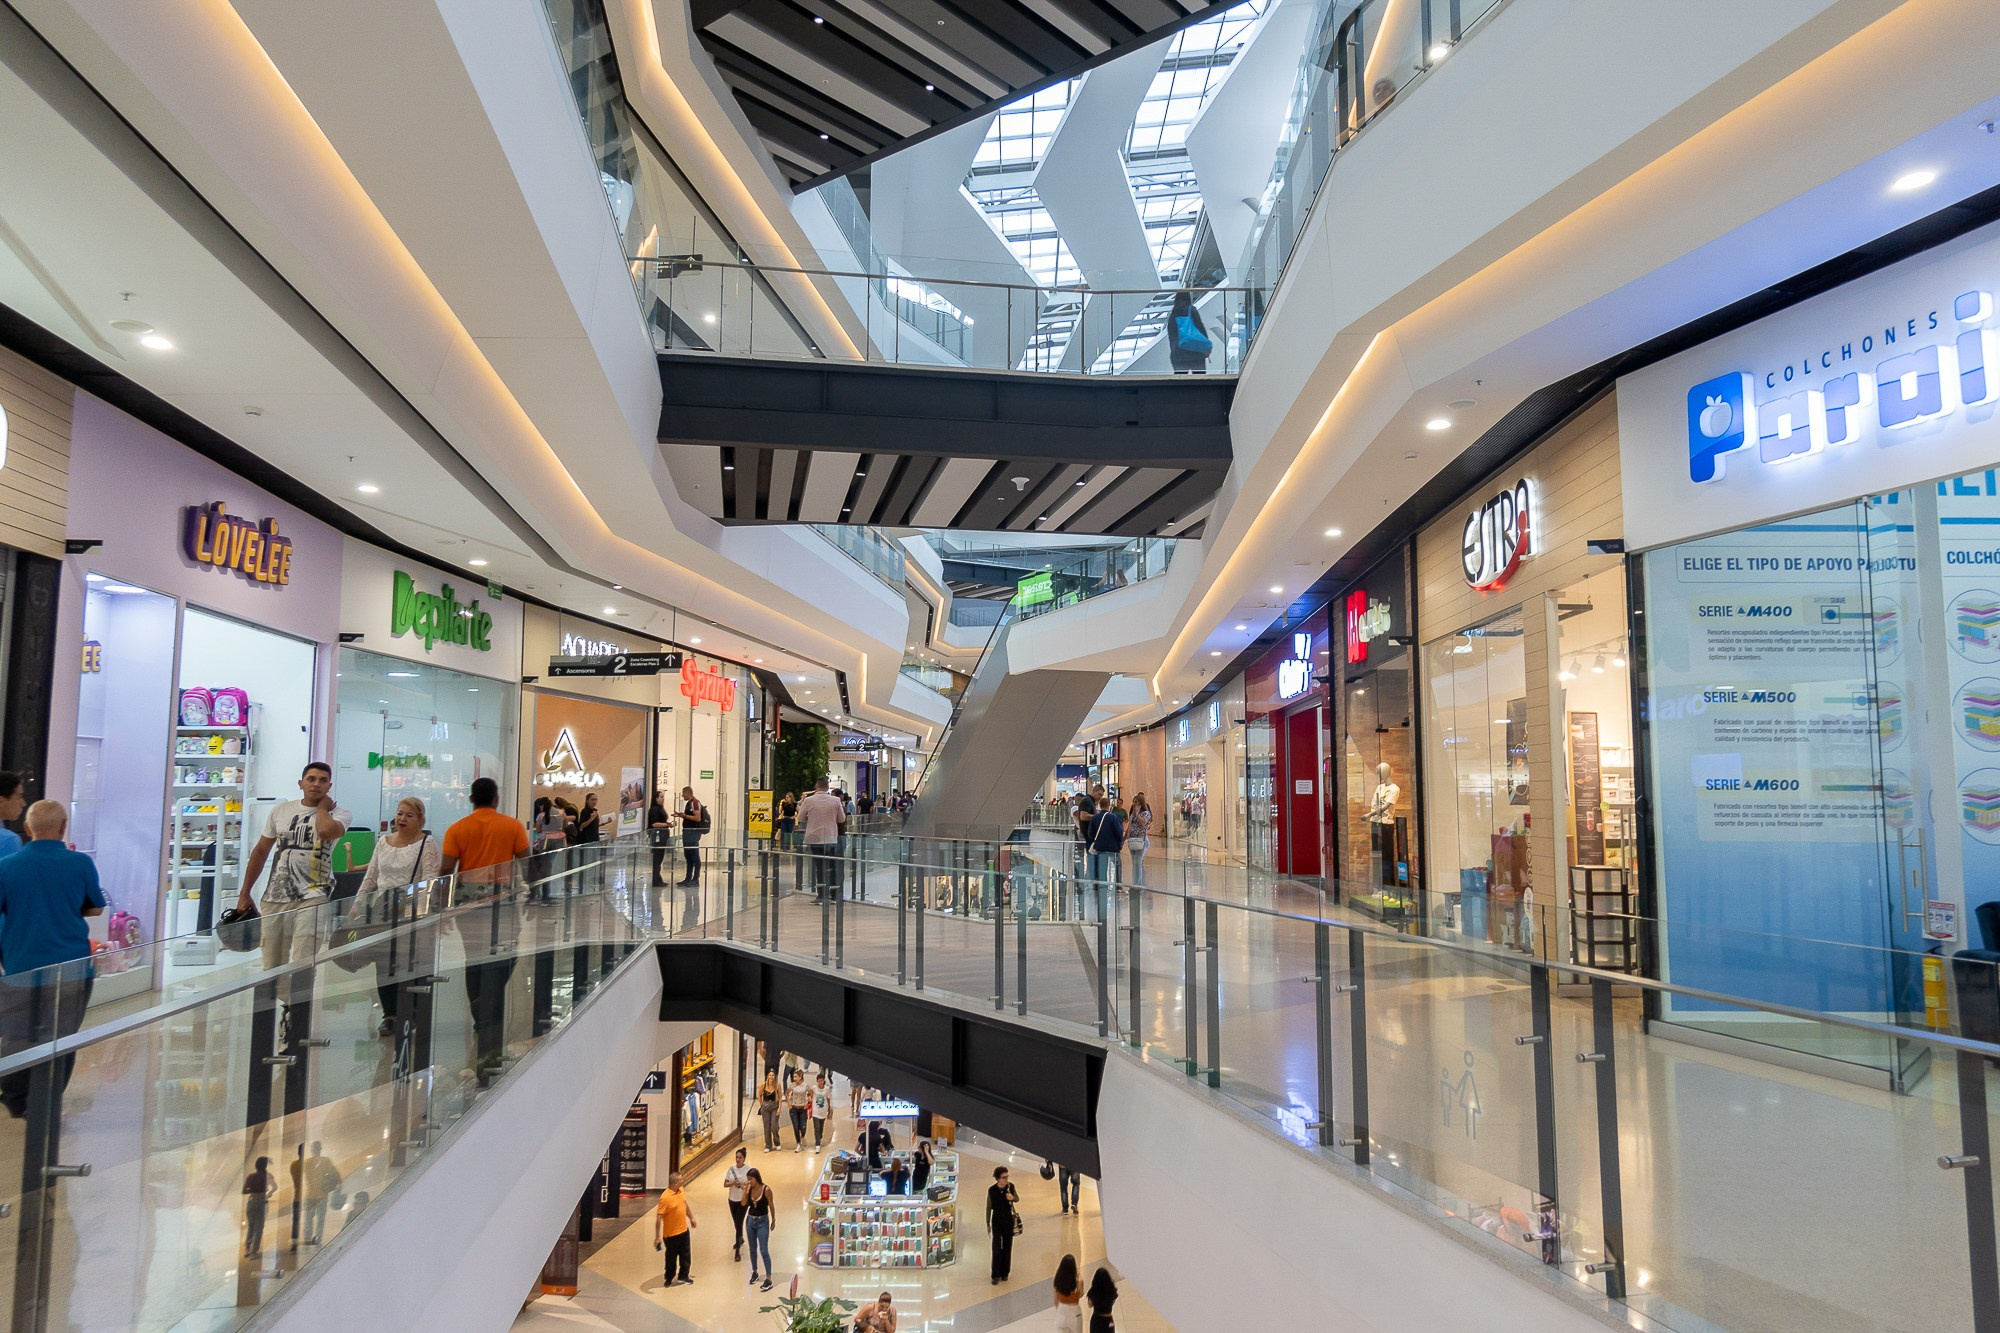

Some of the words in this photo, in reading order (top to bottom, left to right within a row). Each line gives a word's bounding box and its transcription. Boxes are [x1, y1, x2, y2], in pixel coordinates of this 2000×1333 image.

[1765, 311, 1938, 389] COLCHONES
[1461, 478, 1537, 584] ESTRA
[1683, 558, 1722, 571] ELIGE
[1726, 558, 1744, 571] EL
[1746, 558, 1780, 571] TIPO
[1784, 558, 1802, 571] DE
[1806, 558, 1852, 571] APOYO
[392, 570, 493, 651] Depilarte
[1698, 606, 1733, 617] SERIE
[1746, 606, 1793, 617] M400
[614, 656, 626, 674] 2
[680, 658, 735, 713] Spring
[1703, 691, 1738, 703] SERIE
[1750, 691, 1796, 703] M500
[1705, 779, 1741, 790] SERIE
[1753, 779, 1800, 790] M600
